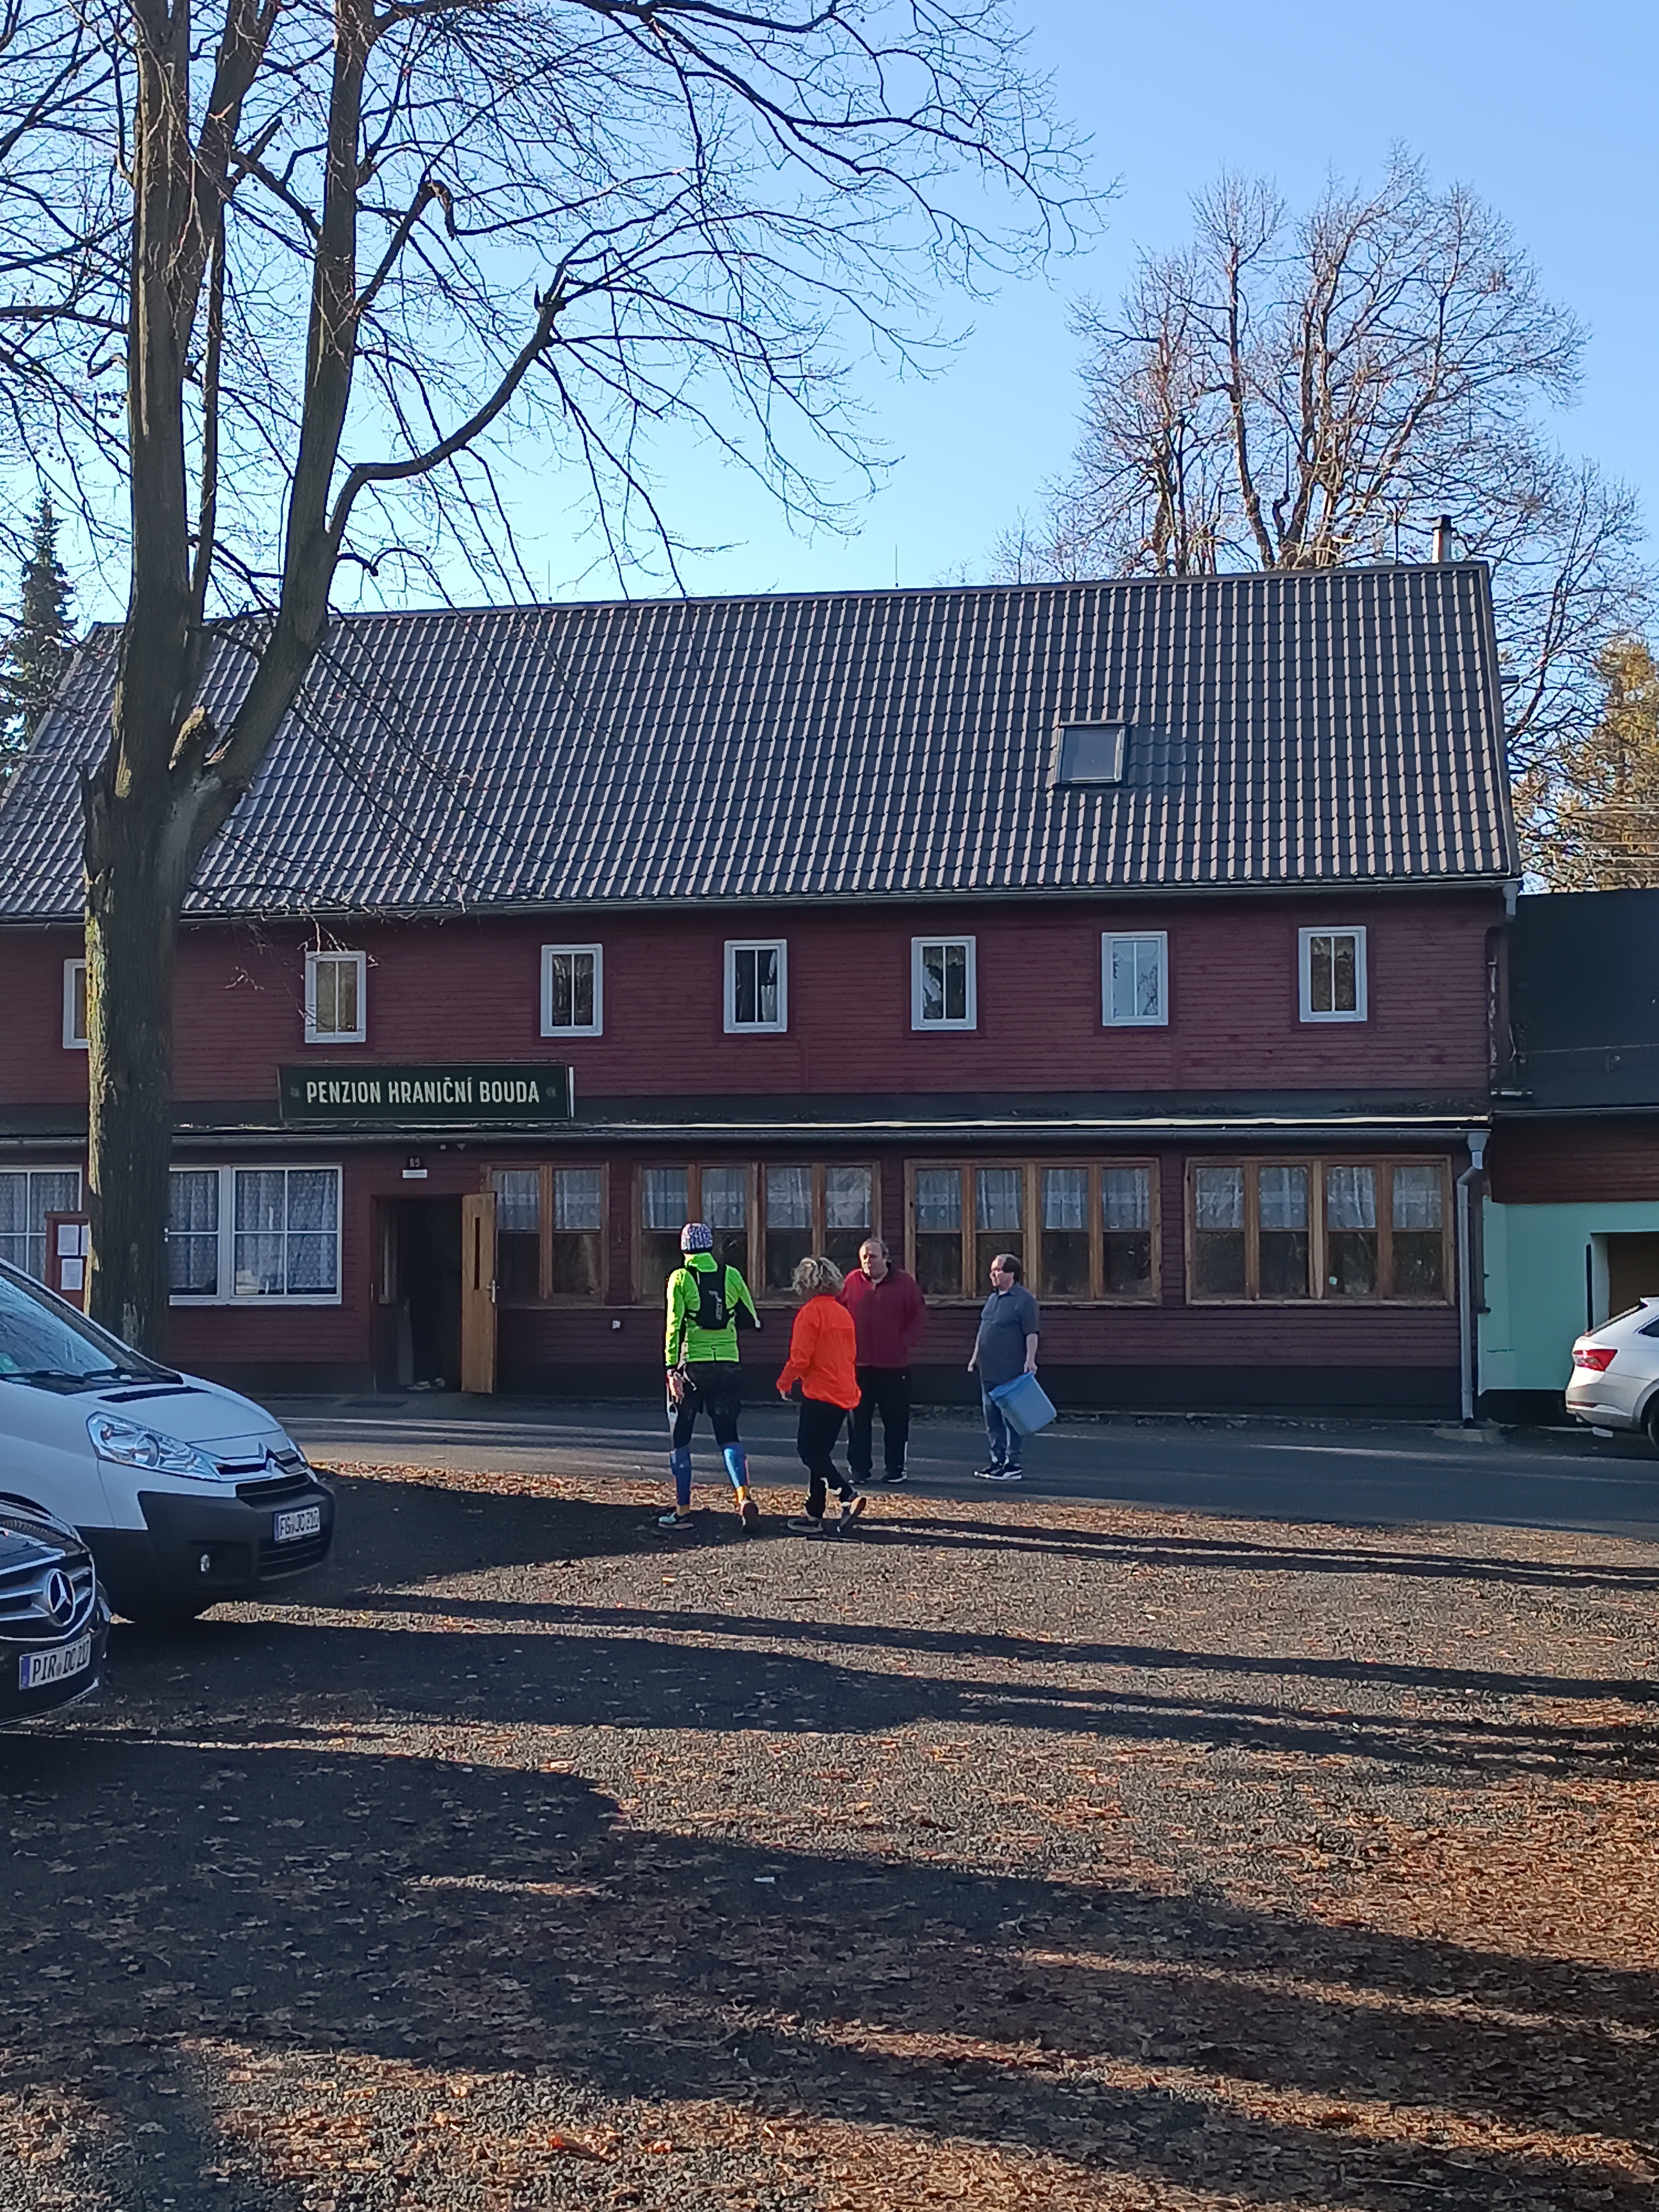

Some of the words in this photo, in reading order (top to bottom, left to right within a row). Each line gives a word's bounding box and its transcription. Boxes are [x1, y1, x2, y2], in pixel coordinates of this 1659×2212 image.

[307, 1081, 381, 1103] PENZION
[388, 1077, 472, 1103] HRANIČNÍ
[479, 1081, 539, 1103] BOUDA
[32, 1654, 57, 1683] PIR
